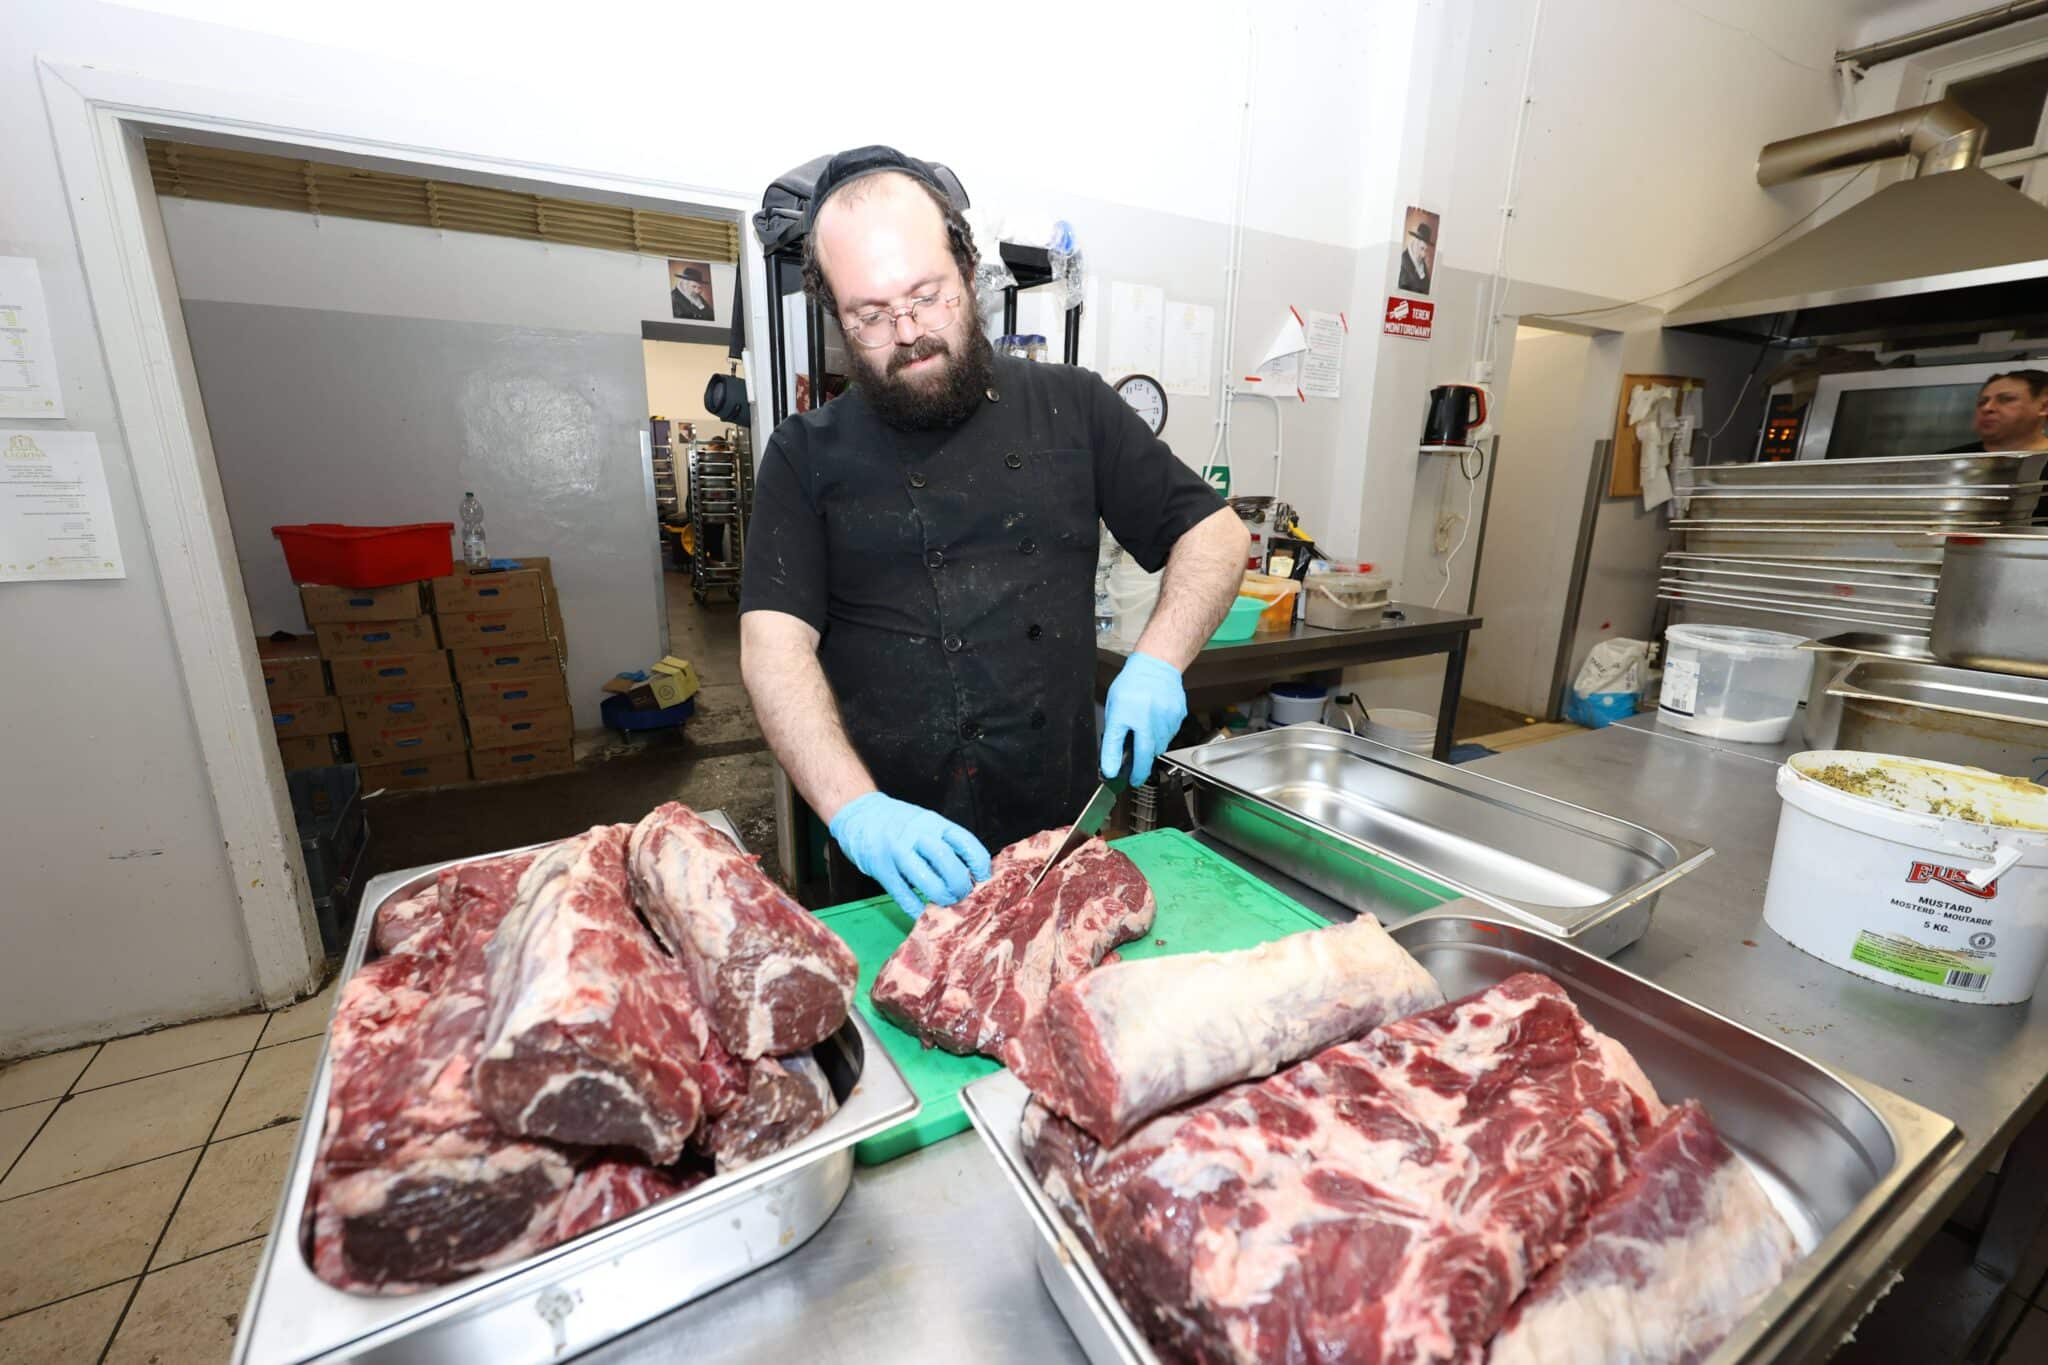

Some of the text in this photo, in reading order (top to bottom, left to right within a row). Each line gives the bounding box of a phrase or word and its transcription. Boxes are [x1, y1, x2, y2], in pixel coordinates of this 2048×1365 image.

[1890, 898, 1935, 915] MOSTERD
[1943, 912, 1993, 927] MOUTARDE
[1918, 896, 1972, 914] MUSTARD
[1923, 921, 1951, 934] 5 KG.
